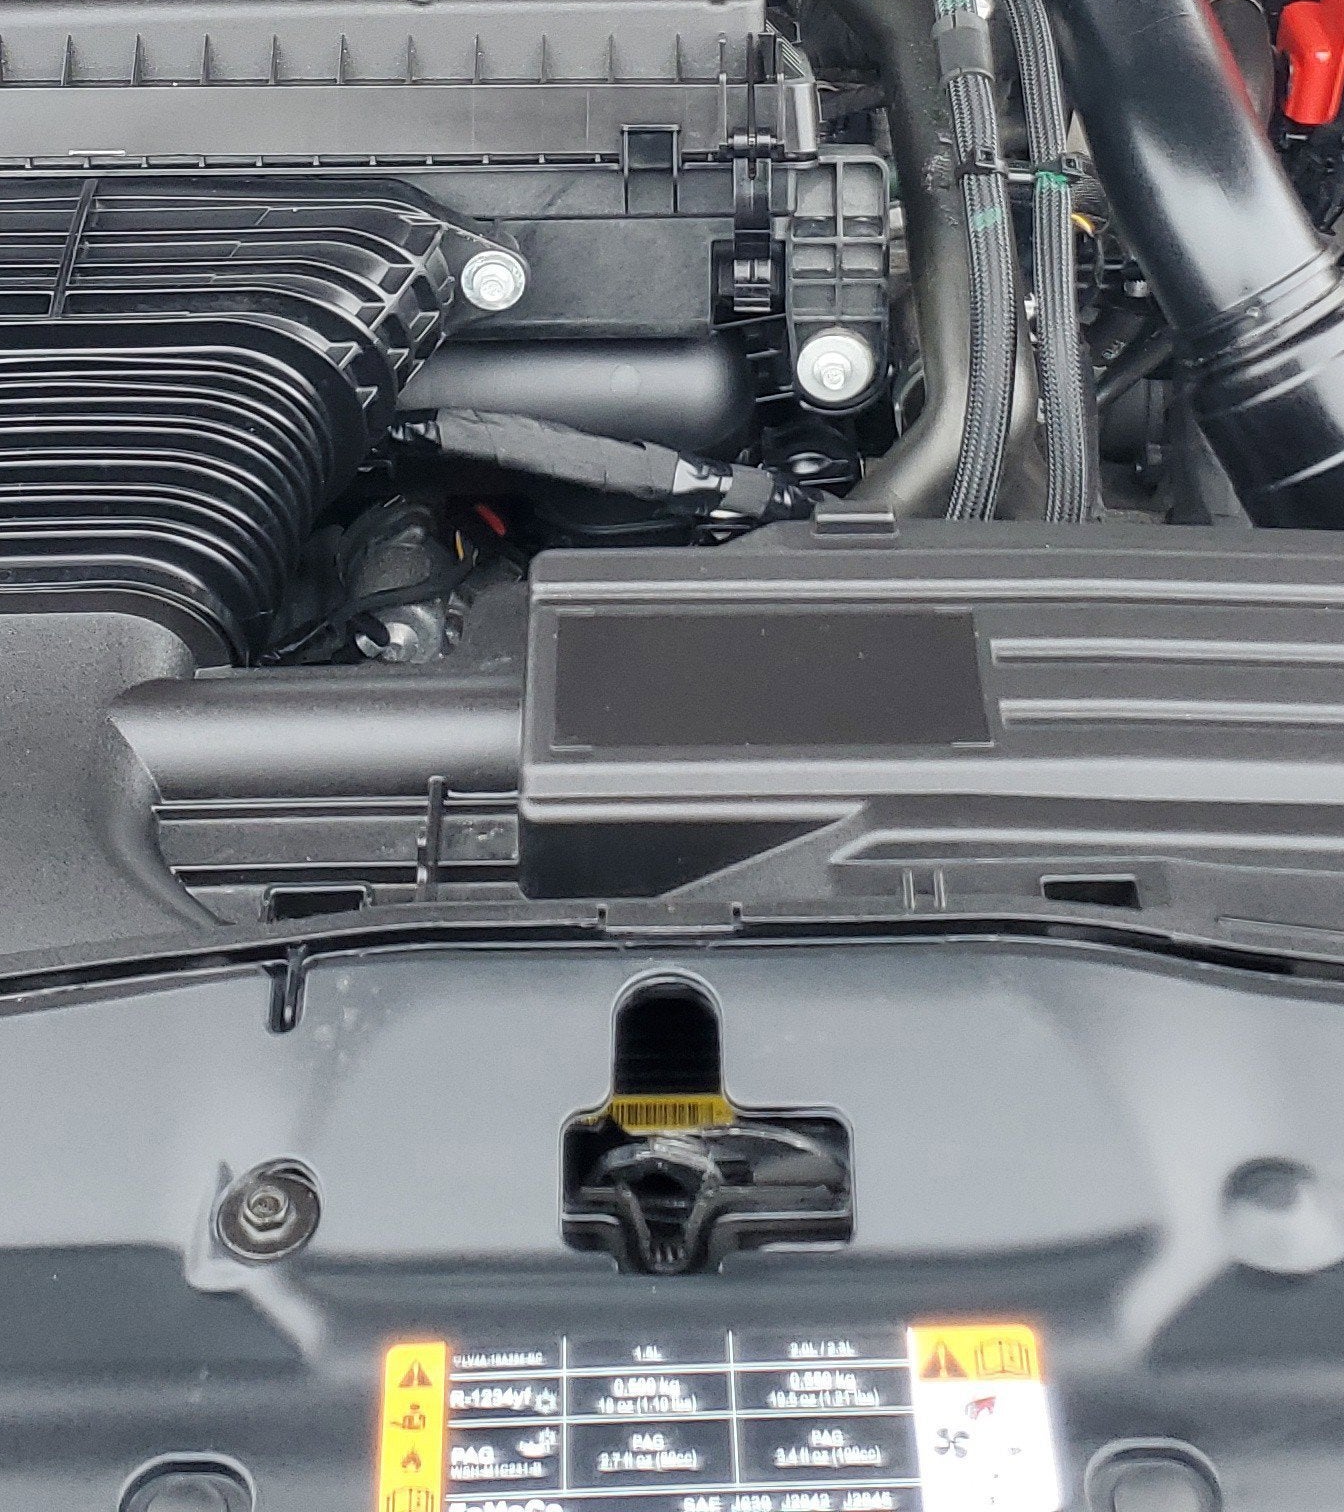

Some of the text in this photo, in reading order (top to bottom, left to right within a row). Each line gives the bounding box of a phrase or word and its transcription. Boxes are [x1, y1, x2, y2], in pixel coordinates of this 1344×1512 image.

[659, 1375, 681, 1400] kg
[835, 1370, 857, 1394] kg
[450, 1386, 533, 1410] R-1234yf
[617, 1399, 635, 1413] oz
[800, 1392, 817, 1407] oz
[633, 1433, 665, 1450] PAG
[811, 1428, 844, 1447] PAG
[451, 1446, 495, 1465] PAG
[624, 1451, 634, 1469] fl
[636, 1453, 653, 1470] oz
[799, 1446, 810, 1465] fl
[812, 1449, 830, 1465] oz
[682, 1495, 722, 1512] SAE
